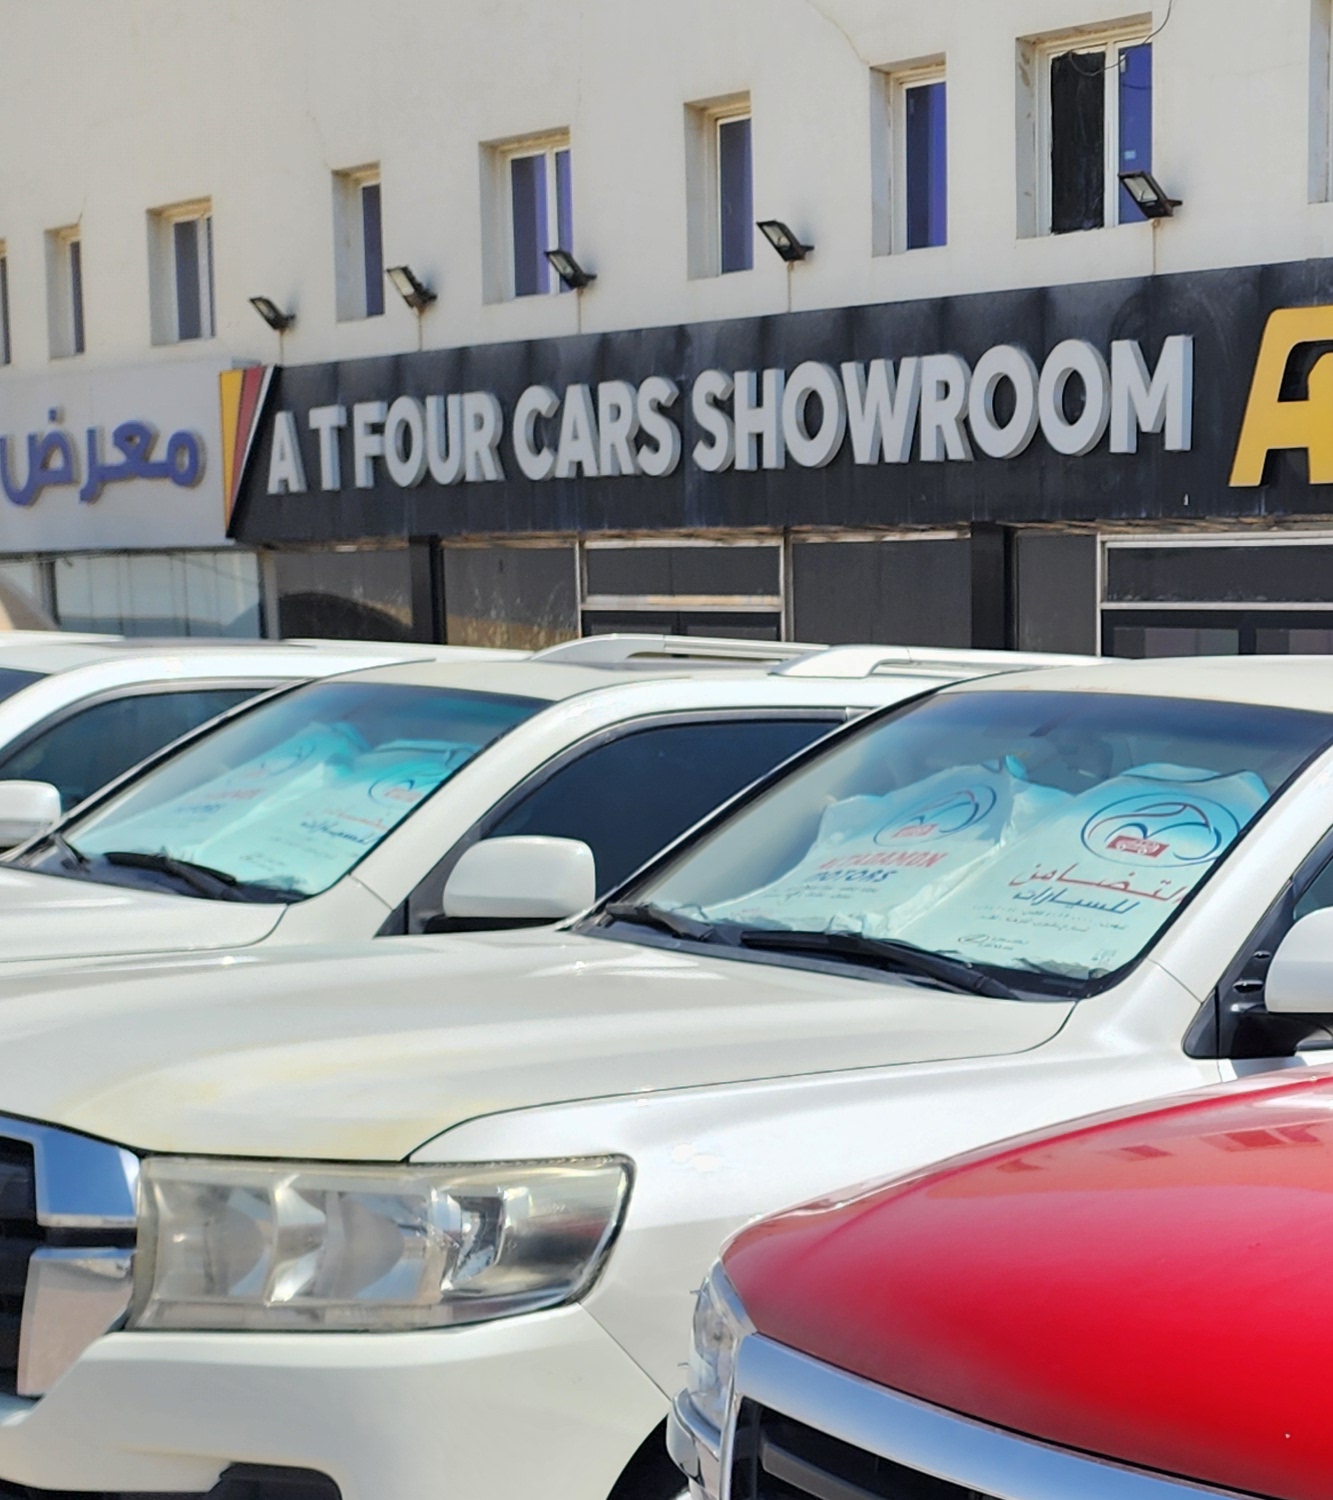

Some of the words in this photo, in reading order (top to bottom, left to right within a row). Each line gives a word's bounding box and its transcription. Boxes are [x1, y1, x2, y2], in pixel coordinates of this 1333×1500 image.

[0, 408, 204, 507] معرض
[353, 388, 503, 491] FOUR
[512, 374, 681, 482] CARS
[692, 334, 1194, 474] SHOWROOM
